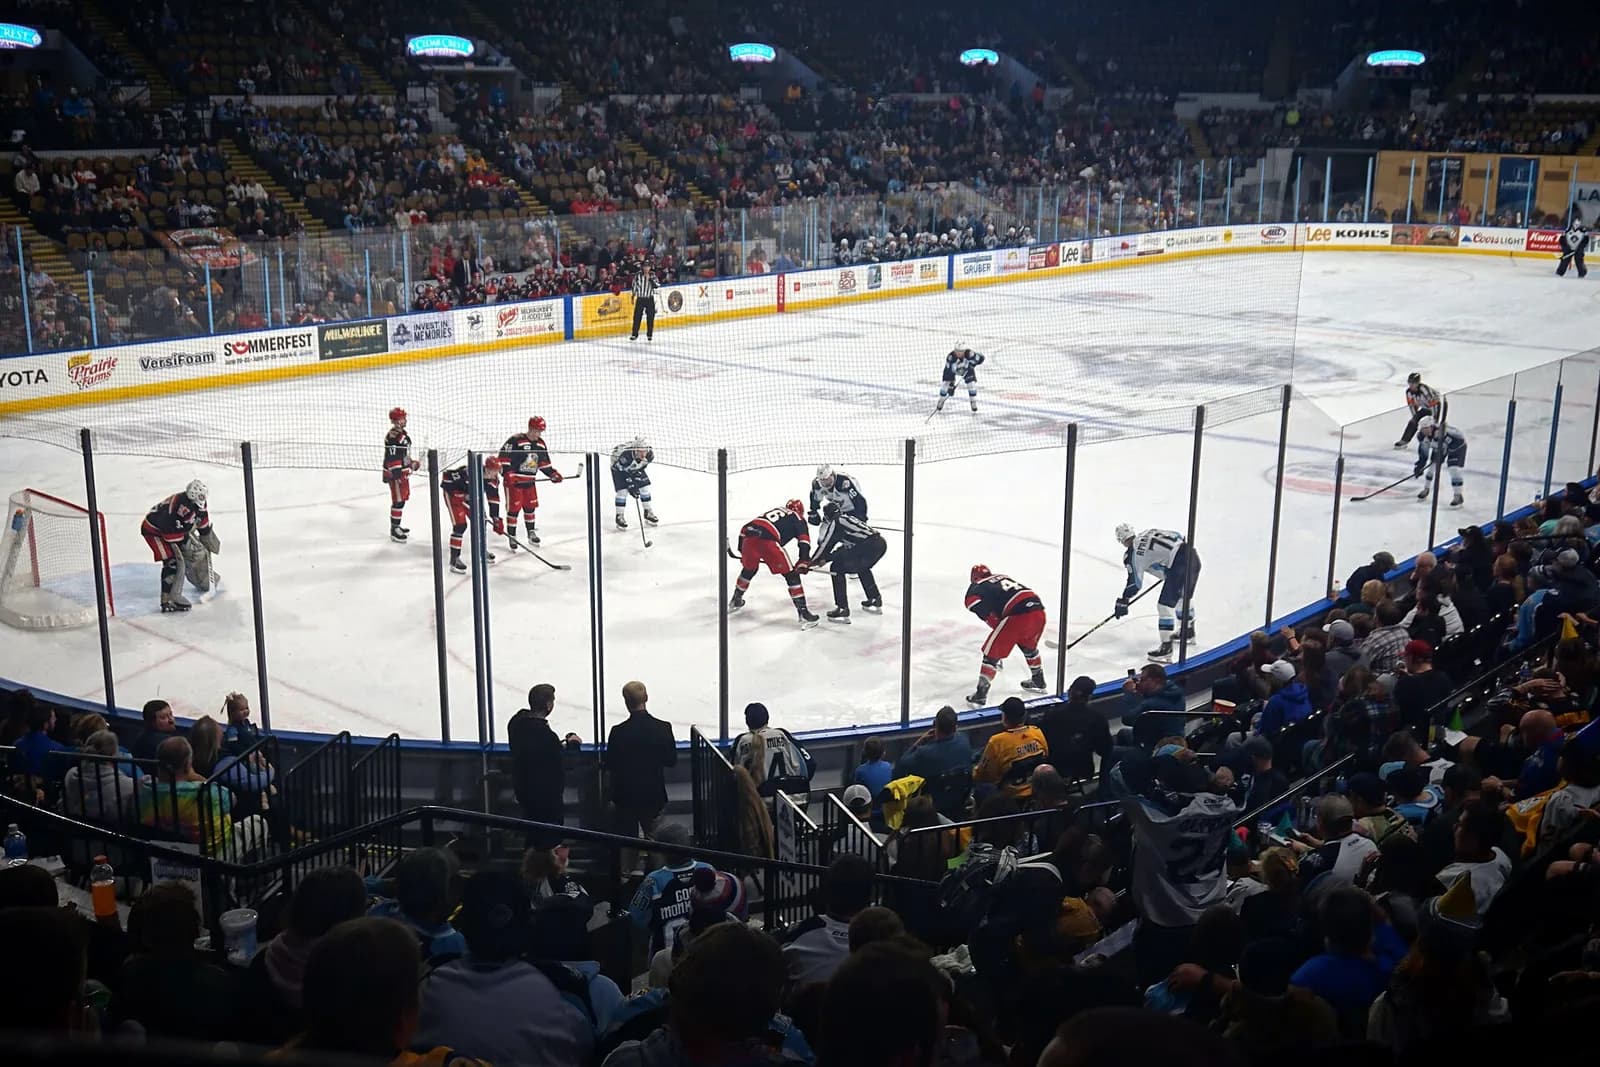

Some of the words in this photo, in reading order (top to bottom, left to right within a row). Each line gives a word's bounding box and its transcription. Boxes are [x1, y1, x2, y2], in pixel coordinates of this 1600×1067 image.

[1306, 226, 1331, 242] Lee
[1335, 229, 1390, 239] KOHL'S
[1473, 232, 1499, 243] Coors
[1500, 236, 1525, 245] LIGHT
[1062, 246, 1078, 263] Lee
[840, 271, 855, 279] BIG
[963, 264, 991, 274] GRUBER
[324, 324, 382, 341] MILWAUKEE
[413, 322, 439, 331] INVEST
[413, 328, 453, 341] MEMORIES
[139, 351, 216, 371] VersiFoam
[69, 356, 118, 381] Prairie
[81, 371, 113, 388] Farms
